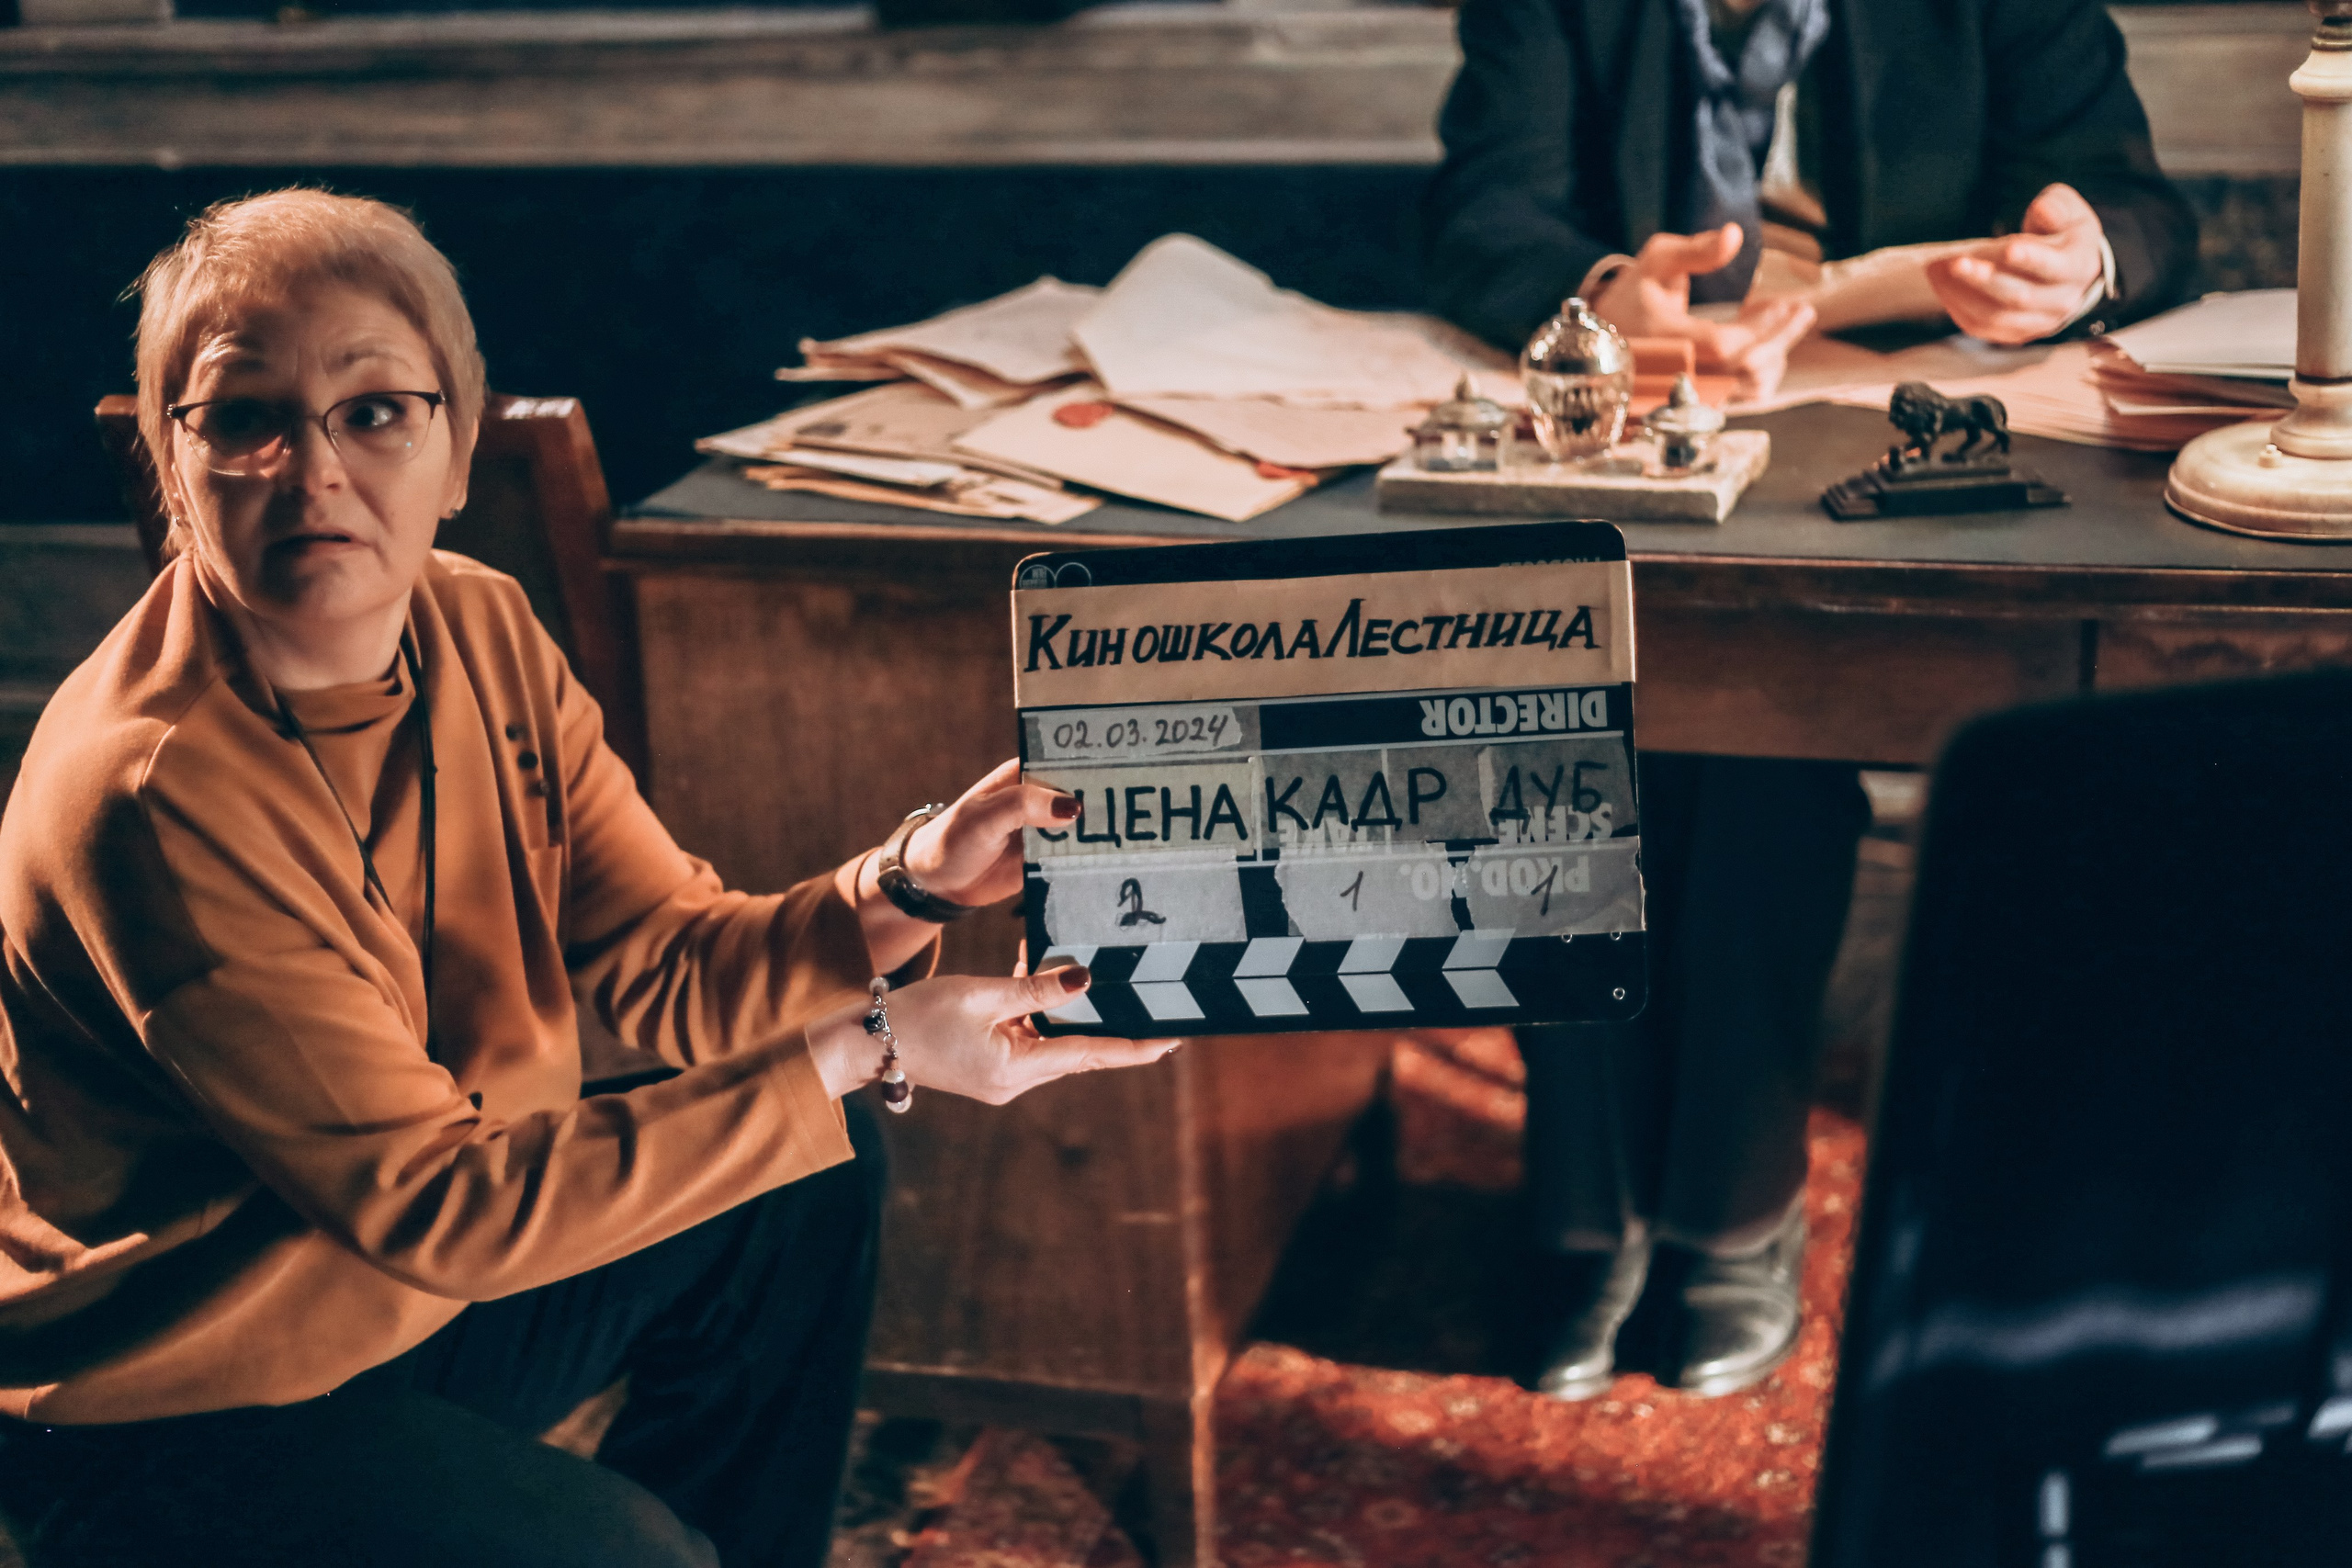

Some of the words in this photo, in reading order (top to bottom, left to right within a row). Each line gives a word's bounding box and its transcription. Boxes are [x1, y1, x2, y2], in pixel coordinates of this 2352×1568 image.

[1053, 714, 1229, 750] 02.03.2024
[1419, 690, 1609, 737] DIRECTOR
[1264, 766, 1447, 833] КАДР
[1489, 761, 1609, 835] ДУБ
[1498, 802, 1613, 846] SCENE
[1340, 870, 1364, 912] 1
[1469, 854, 1591, 897] PROD.
[1530, 864, 1559, 917] 1
[1116, 876, 1167, 927] 2
